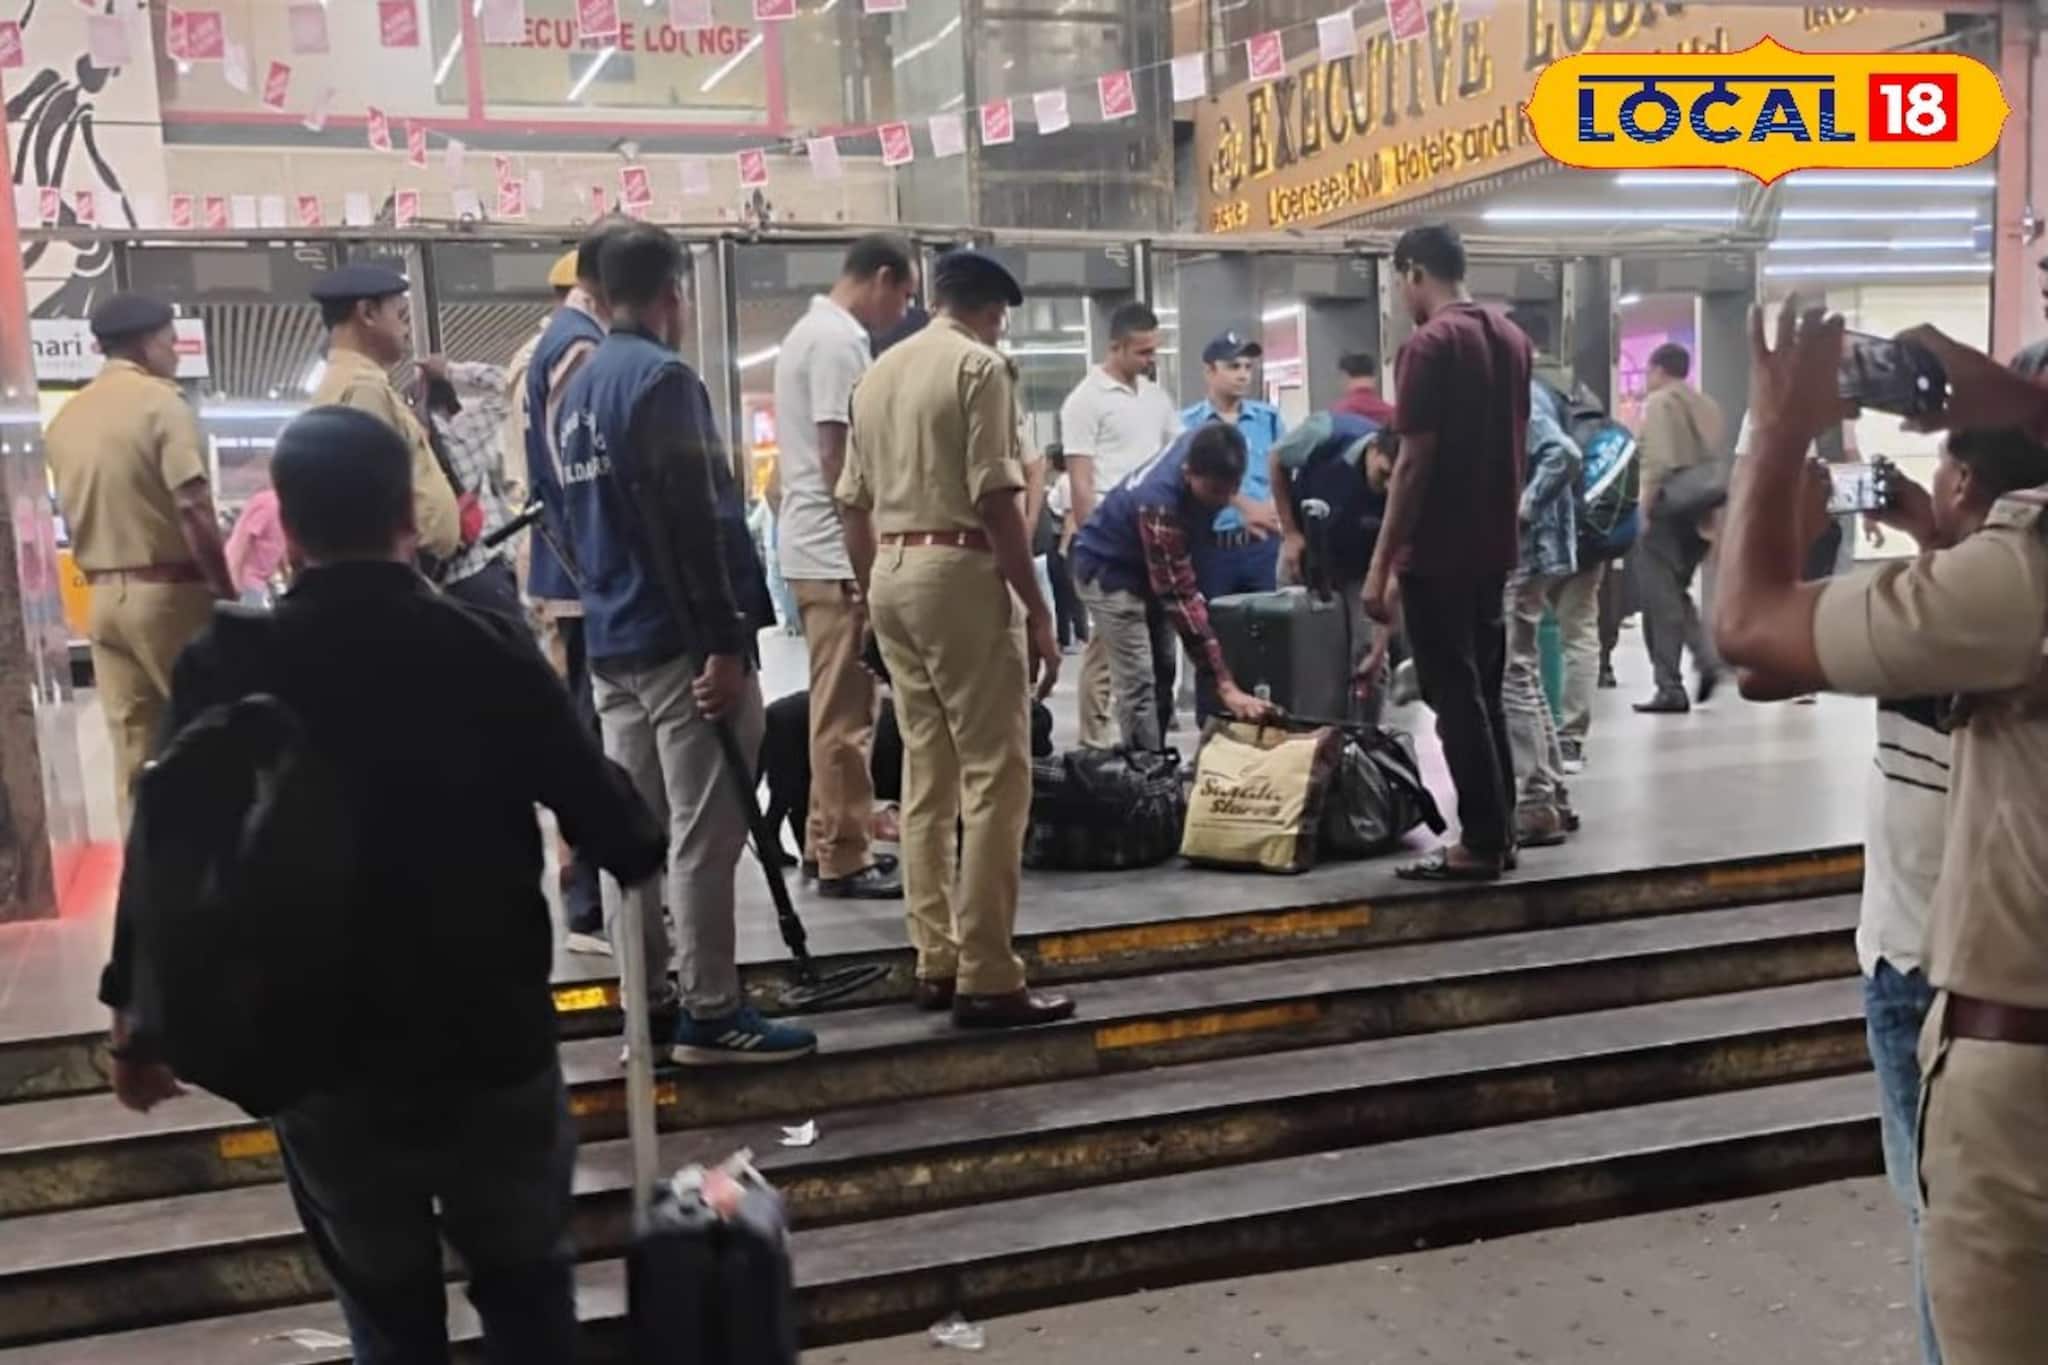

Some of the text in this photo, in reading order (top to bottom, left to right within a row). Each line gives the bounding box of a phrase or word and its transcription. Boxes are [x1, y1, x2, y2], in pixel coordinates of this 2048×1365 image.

[1247, 0, 1494, 178] EXECUTIVE
[1393, 127, 1459, 188] Hotels
[1461, 104, 1514, 166] and
